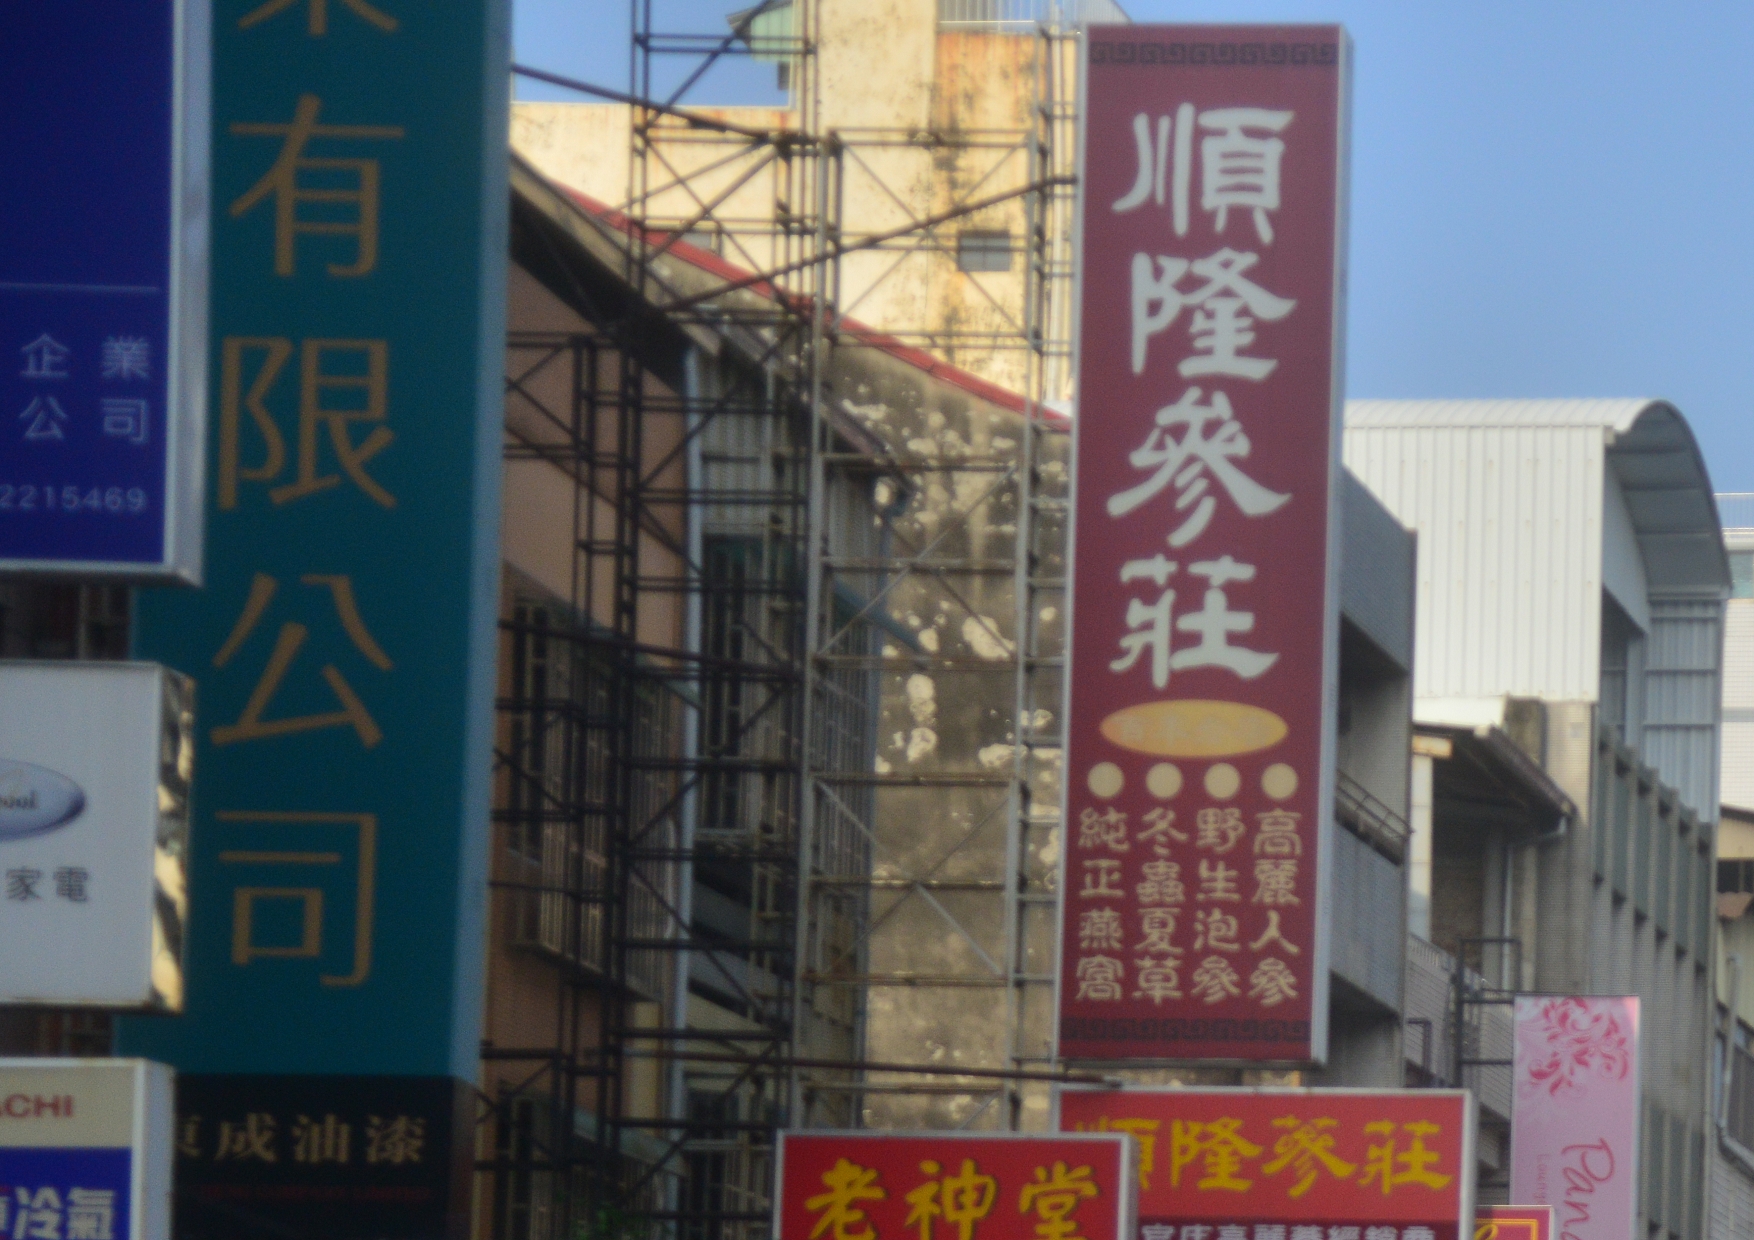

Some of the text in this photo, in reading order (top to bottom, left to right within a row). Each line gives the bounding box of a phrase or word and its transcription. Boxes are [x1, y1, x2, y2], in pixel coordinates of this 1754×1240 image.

[20, 335, 150, 379] 企業
[19, 398, 150, 443] 公司
[211, 0, 404, 988] 有限公司
[4, 866, 90, 903] 家電
[1132, 806, 1188, 1006] 冬蟲夏草
[0, 1093, 75, 1120] CHI
